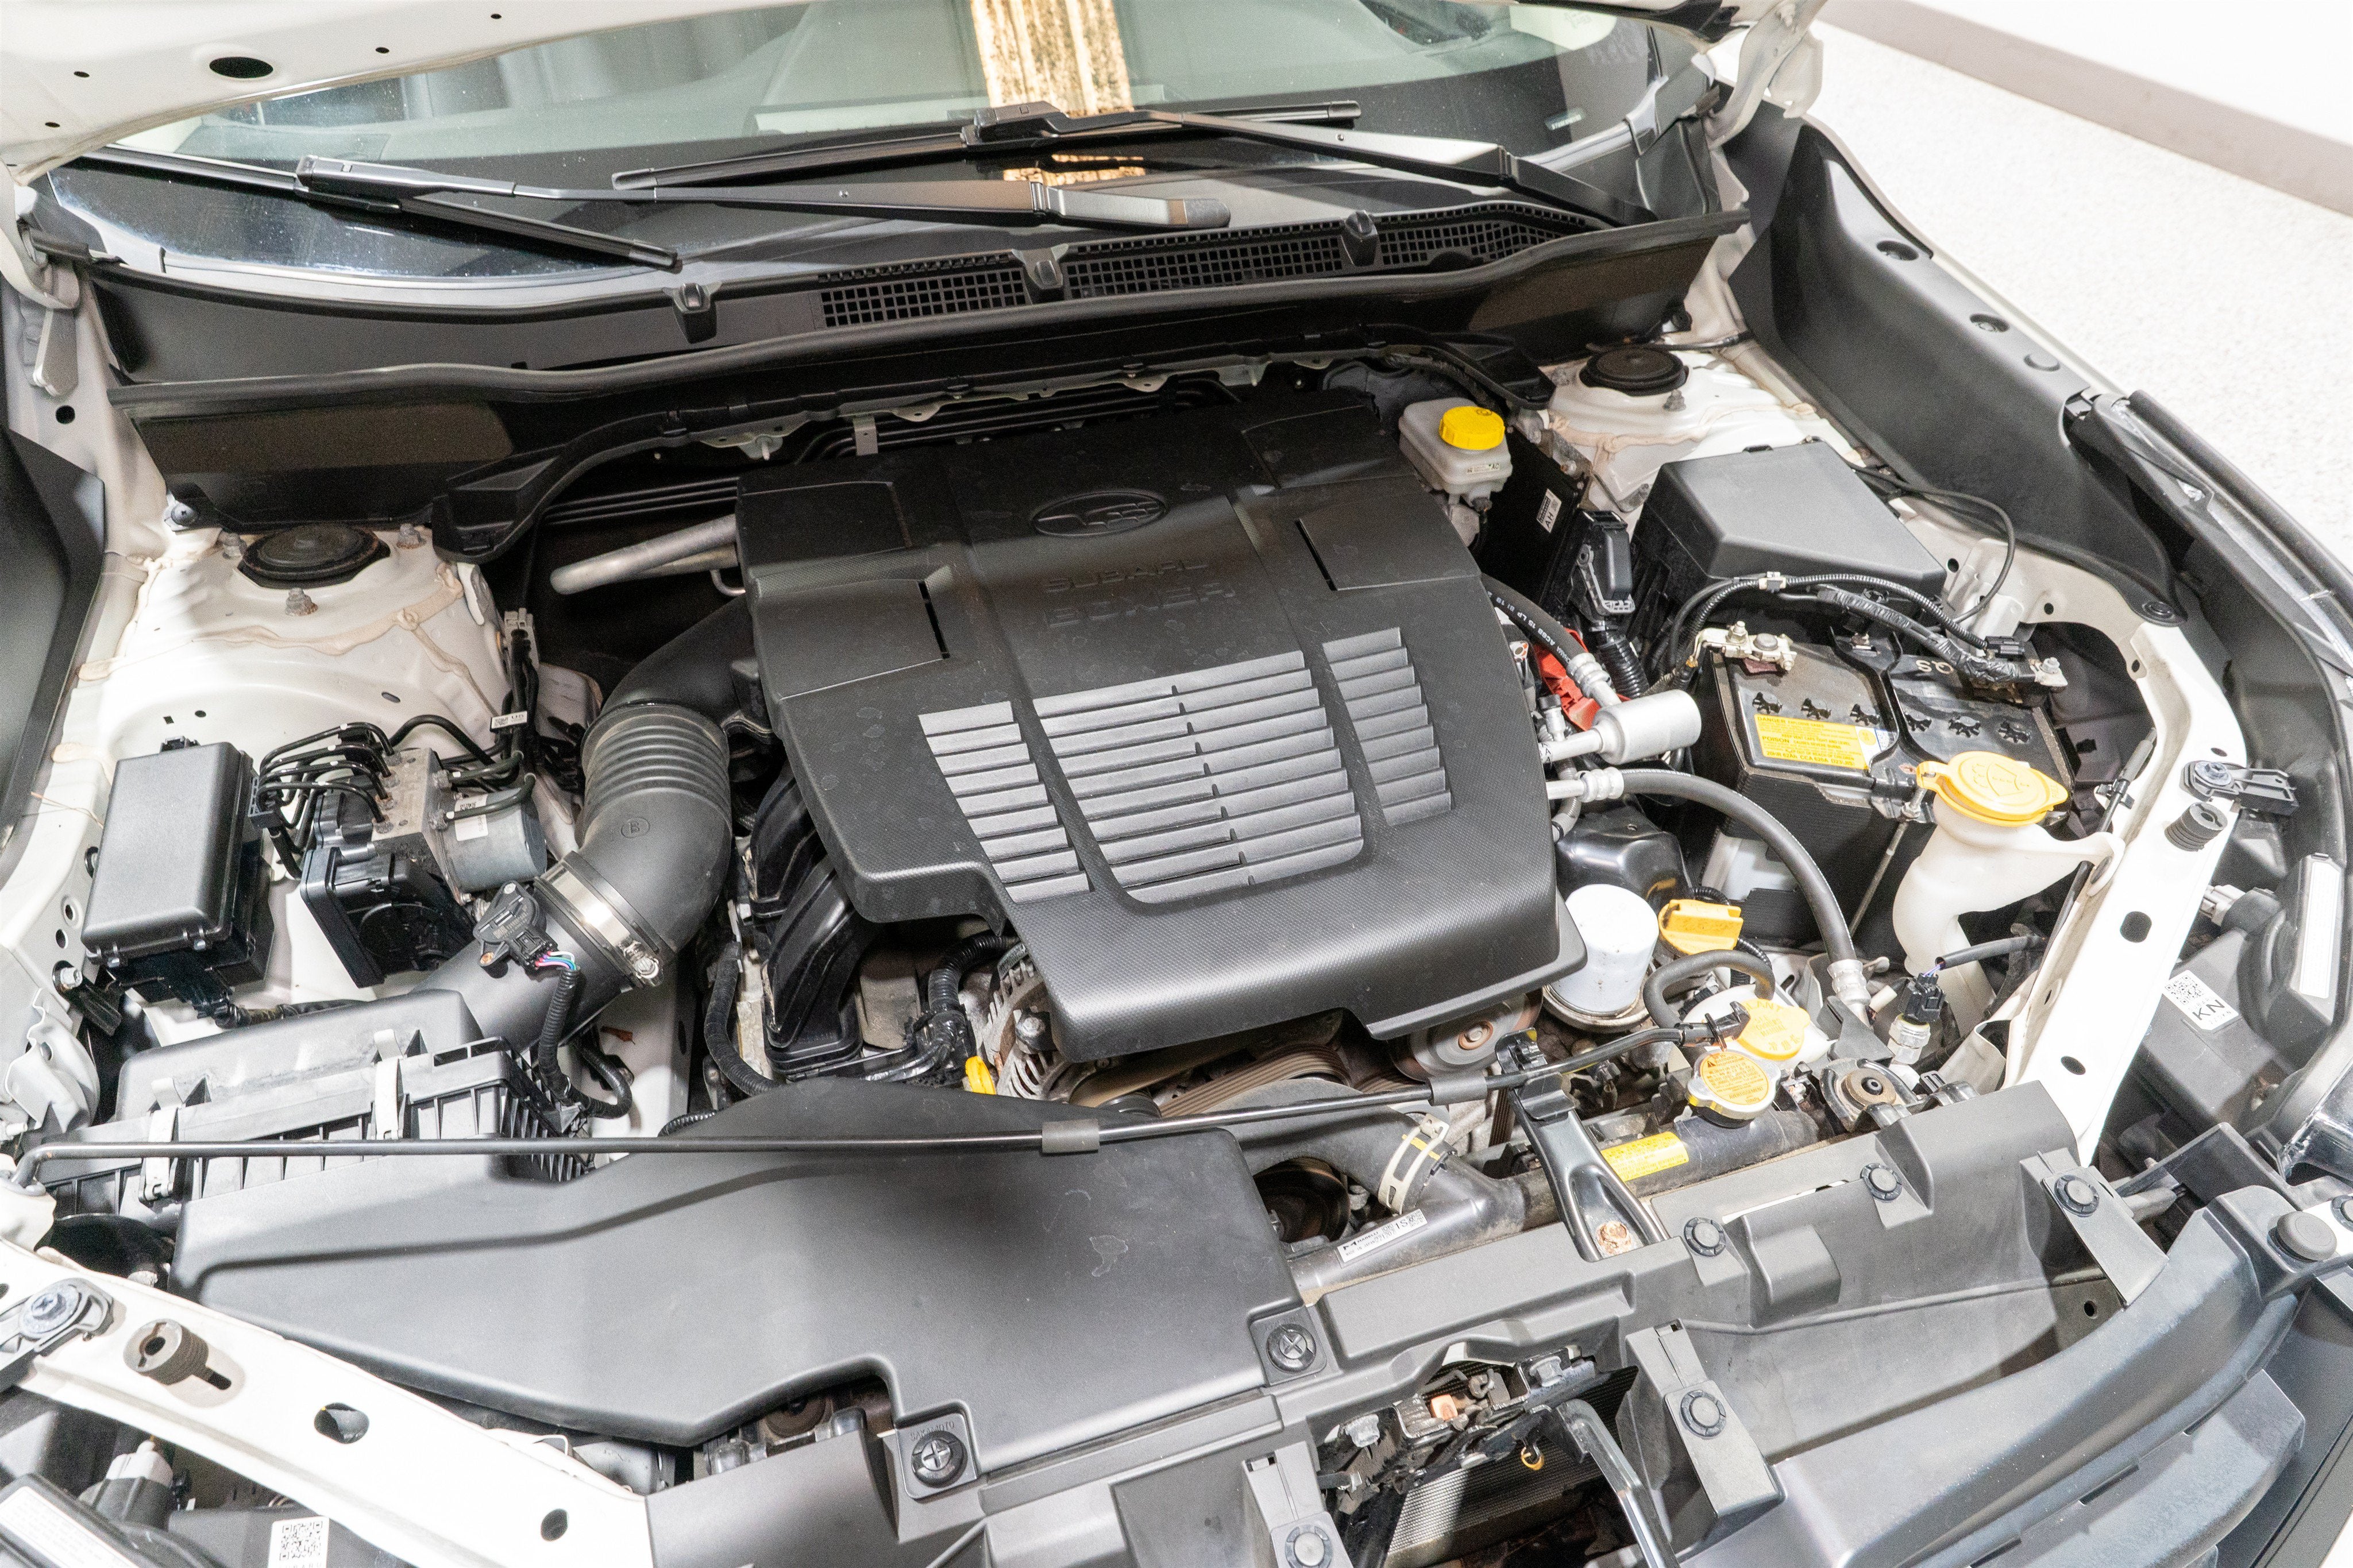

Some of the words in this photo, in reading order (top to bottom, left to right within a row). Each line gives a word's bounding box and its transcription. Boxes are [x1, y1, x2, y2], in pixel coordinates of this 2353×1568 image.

[1042, 559, 1209, 593] SUBARU
[1044, 582, 1236, 628] BOXER
[1762, 735, 1789, 743] POISON
[2192, 999, 2225, 1021] KN
